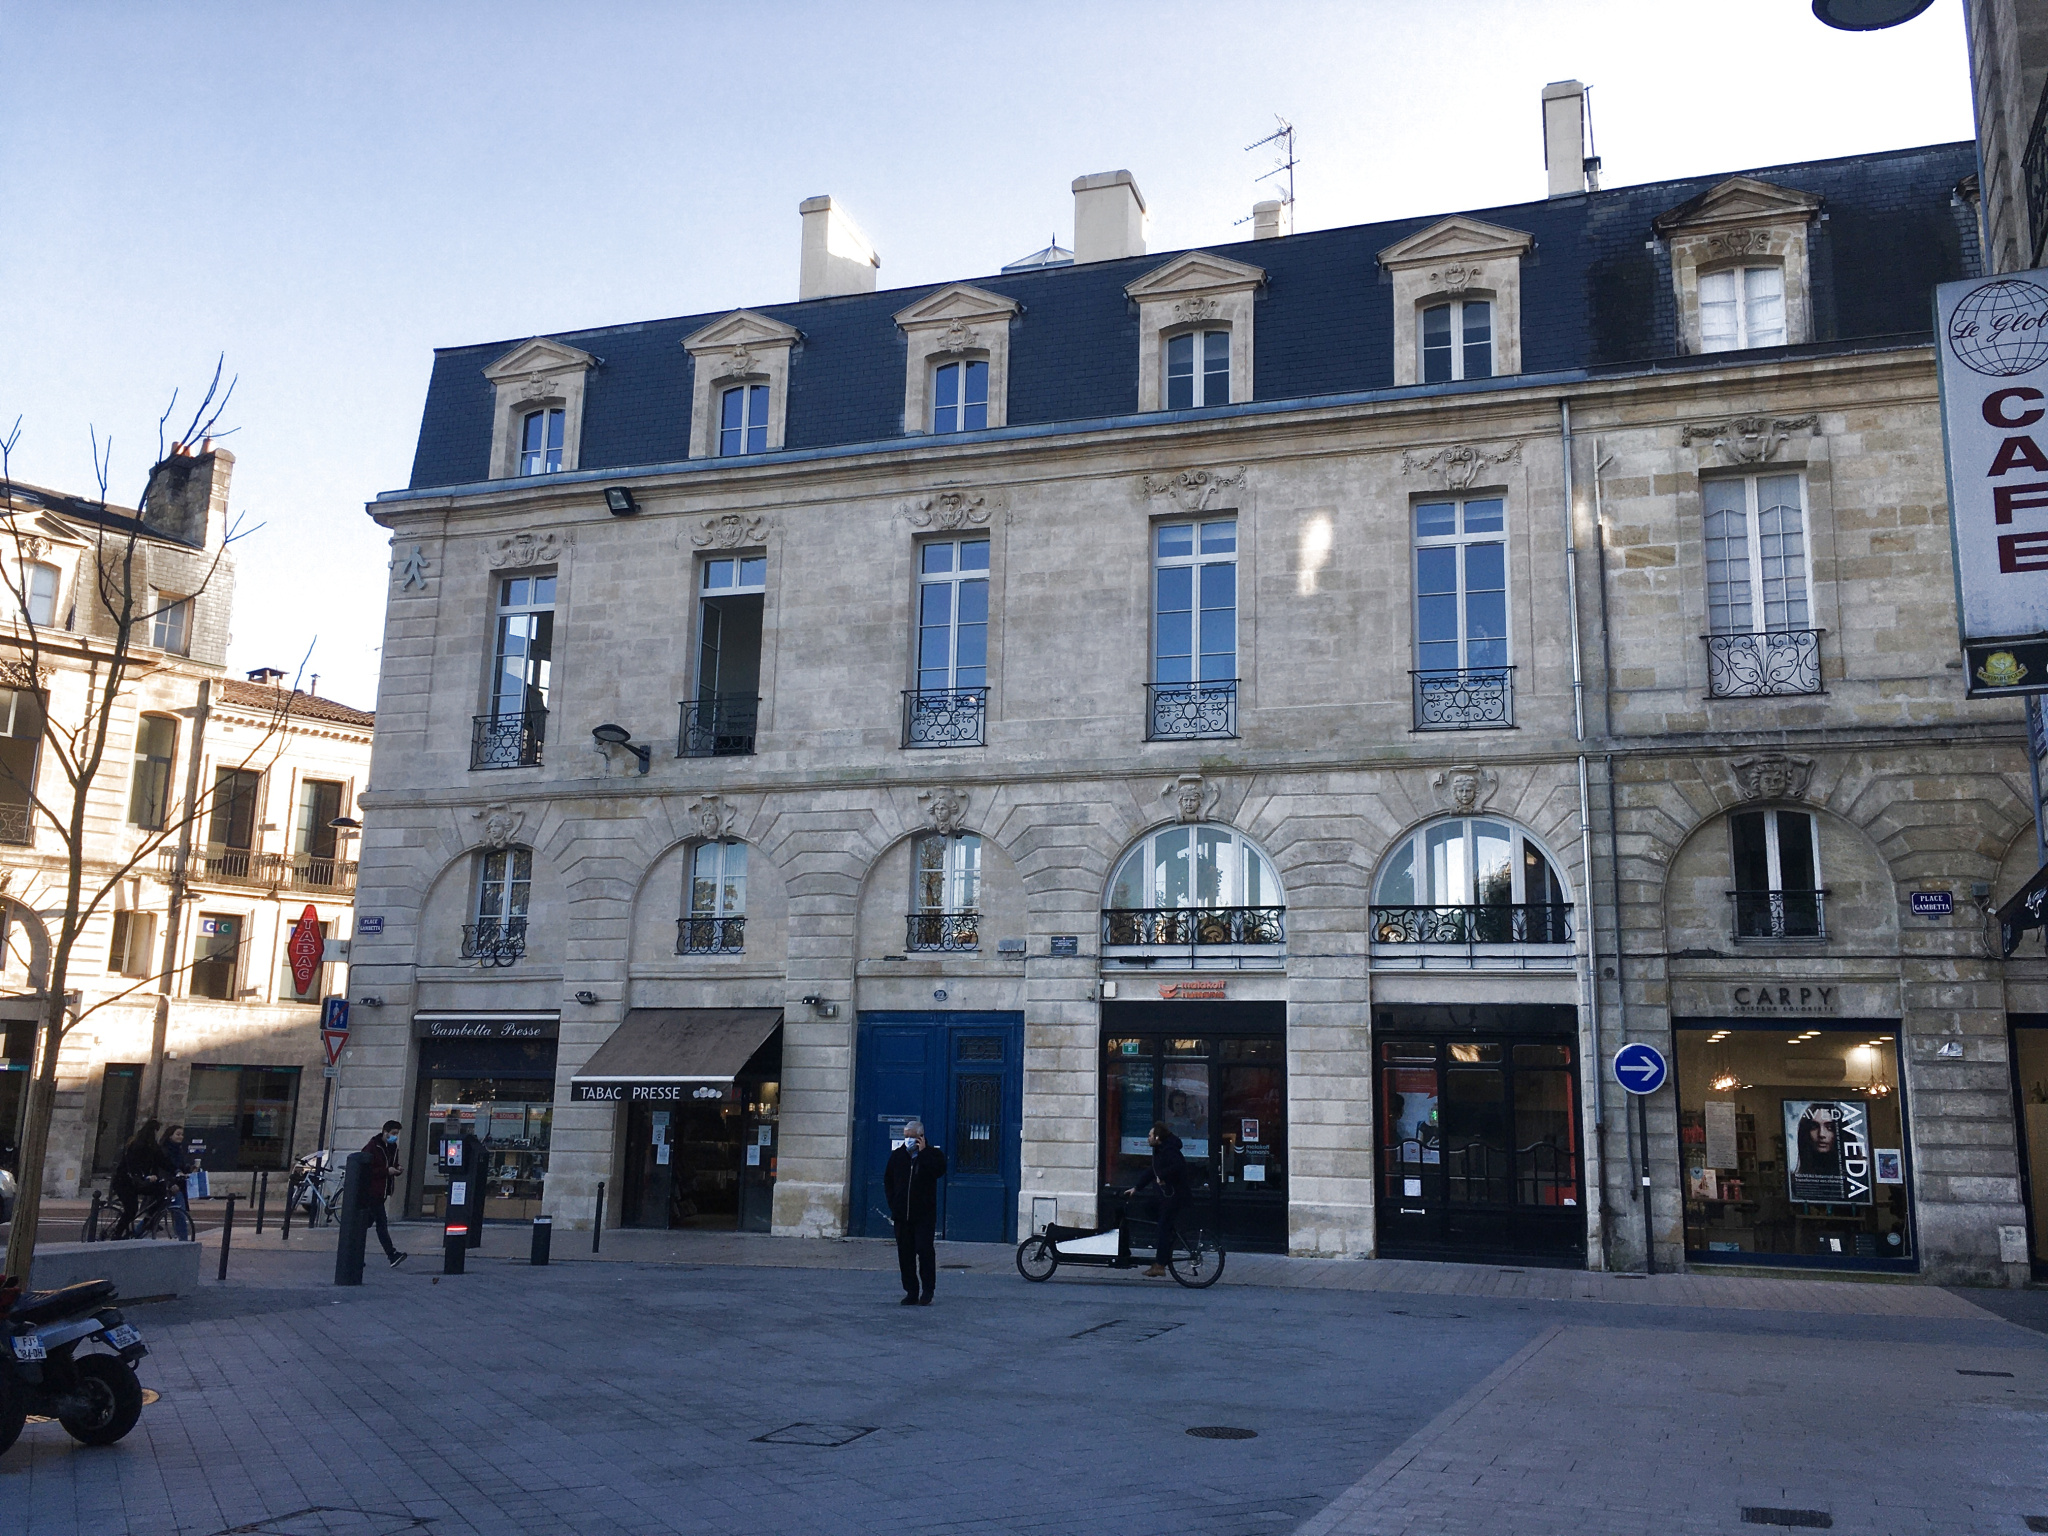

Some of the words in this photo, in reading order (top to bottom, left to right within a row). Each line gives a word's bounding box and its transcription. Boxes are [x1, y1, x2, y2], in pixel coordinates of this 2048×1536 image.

[1952, 320, 1980, 340] Le
[1914, 903, 1950, 911] GAMBETTA
[295, 918, 316, 980] TABAC
[1181, 980, 1226, 989] malakoff
[1734, 987, 1833, 1005] CARPY
[430, 1022, 492, 1037] Gambetta
[500, 1022, 541, 1037] Presse
[580, 1086, 623, 1100] TABAC
[632, 1086, 682, 1100] PRESSE
[1840, 1101, 1870, 1199] AVEDA
